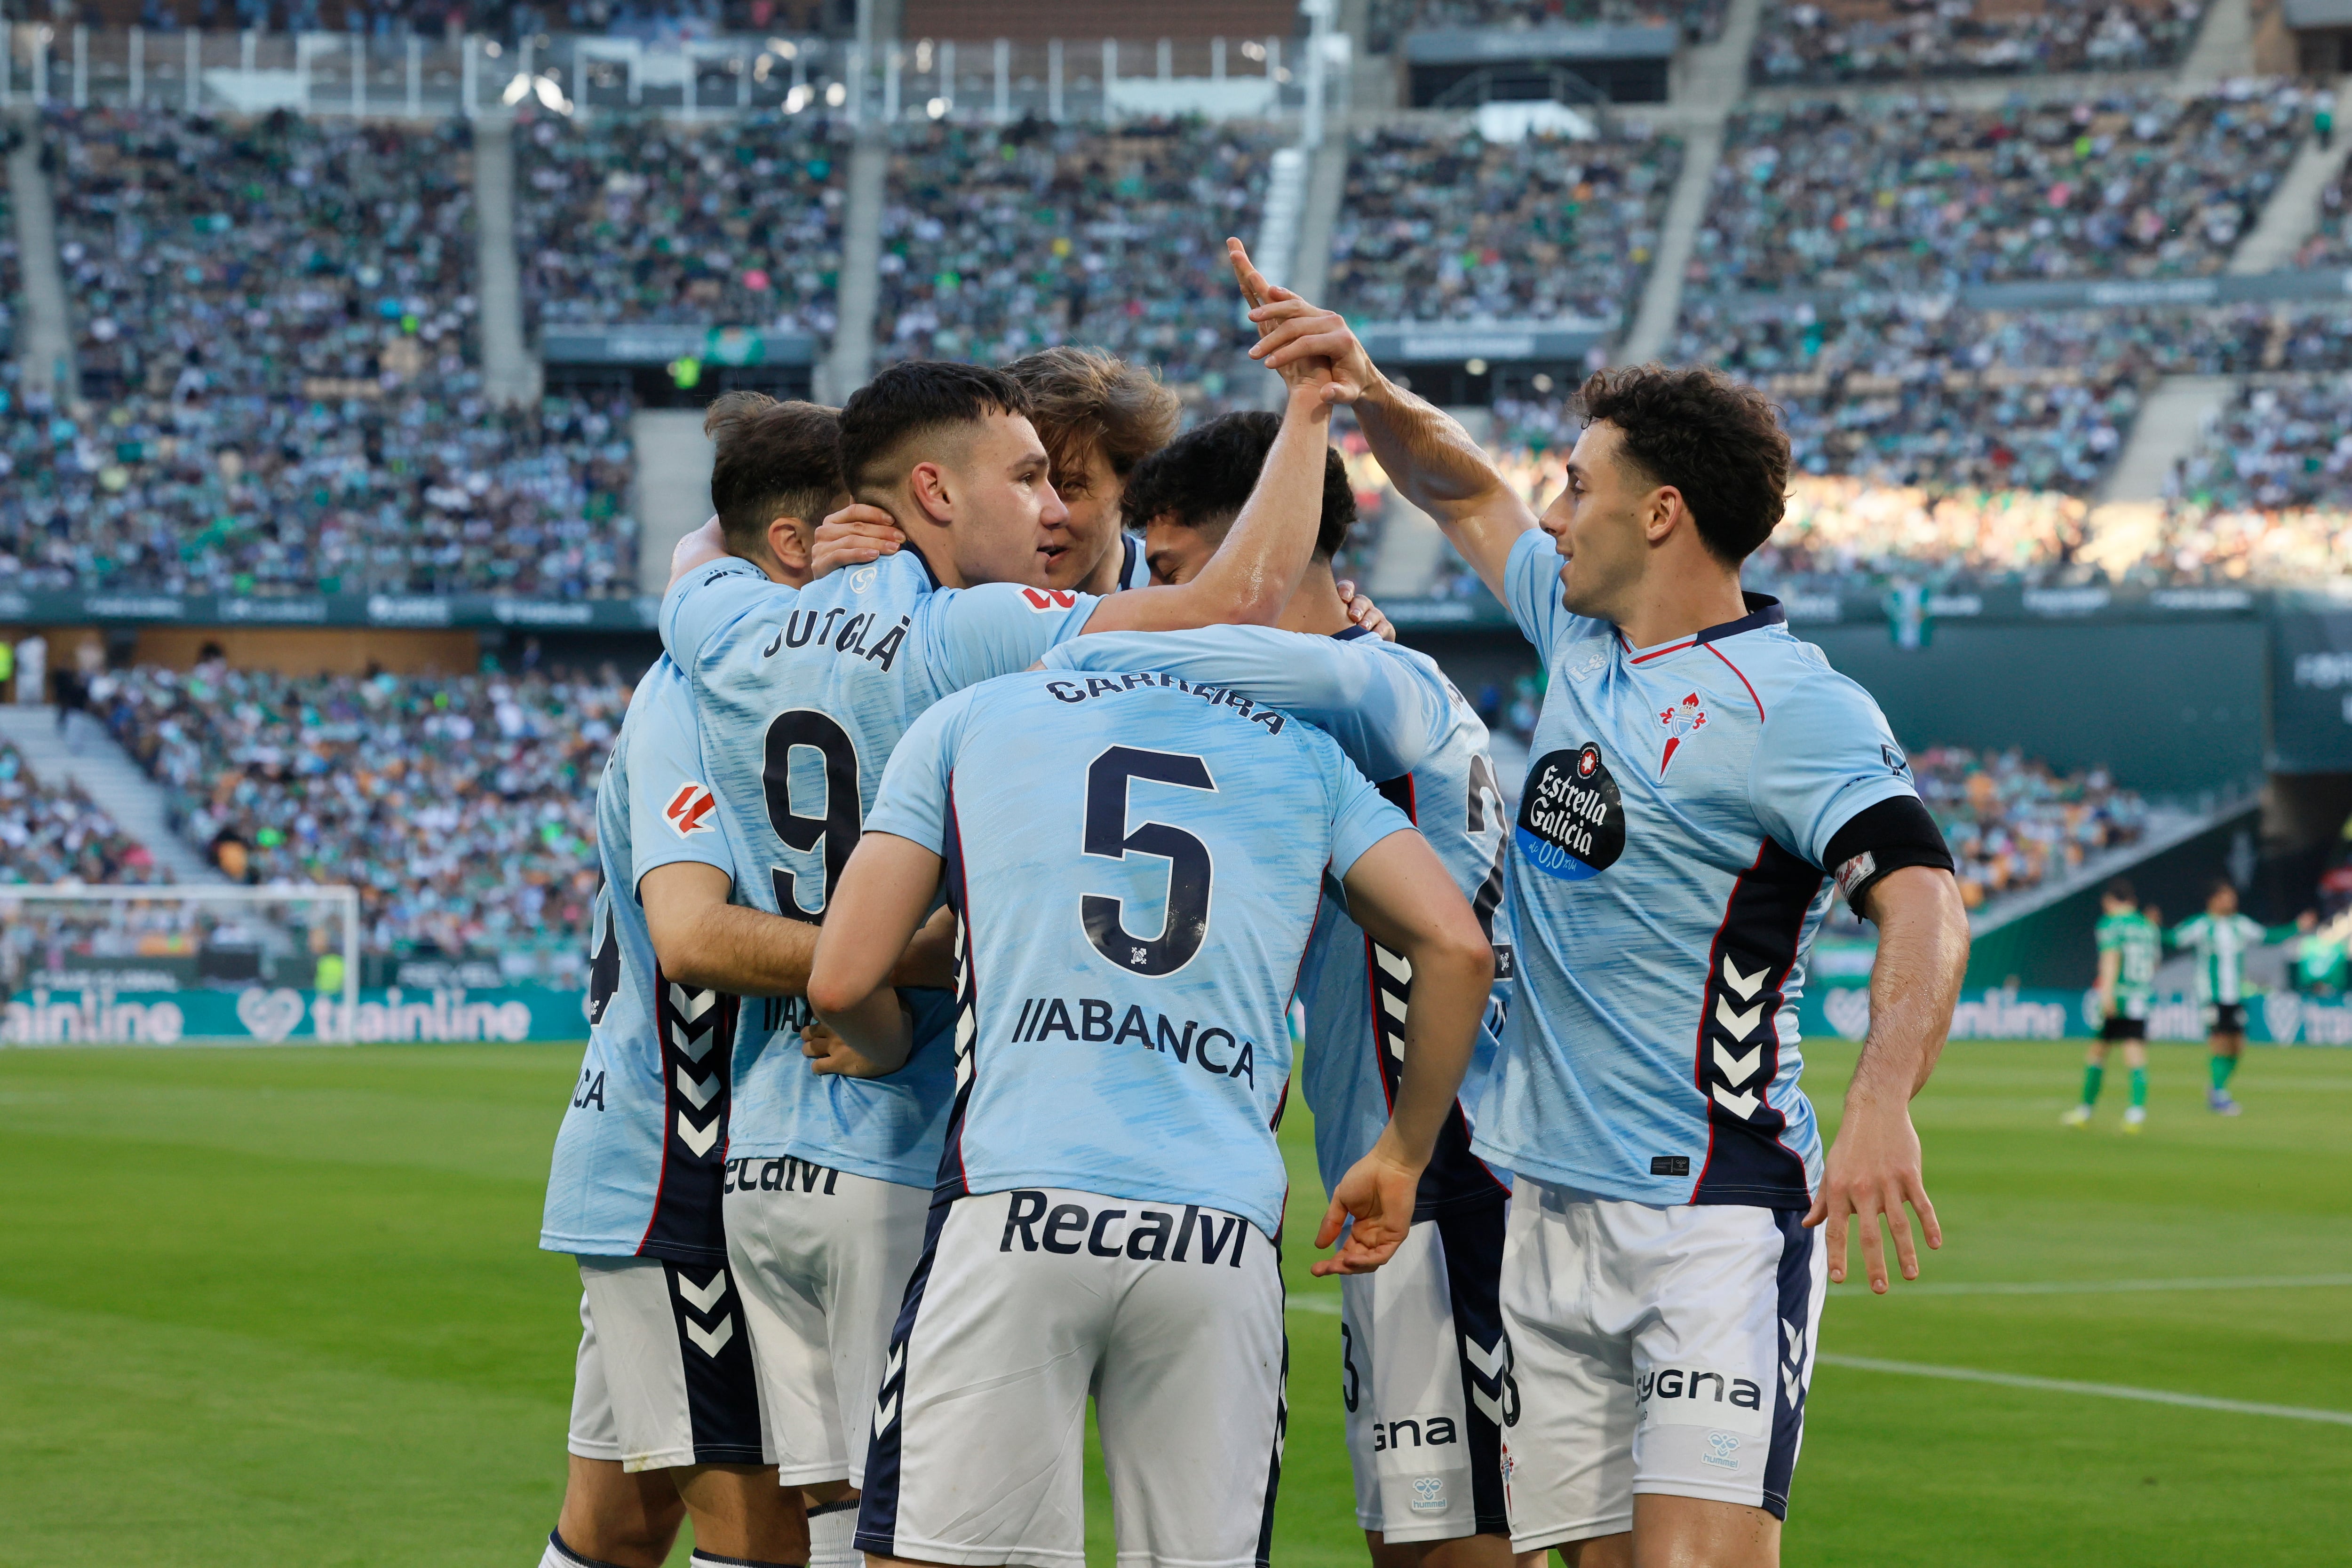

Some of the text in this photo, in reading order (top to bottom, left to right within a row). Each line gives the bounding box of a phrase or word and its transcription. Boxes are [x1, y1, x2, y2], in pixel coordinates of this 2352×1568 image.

[761, 707, 863, 927] 9
[1536, 764, 1607, 826] Estrella
[1530, 796, 1592, 856] Galicia
[1539, 840, 1565, 869] 0,0
[1079, 743, 1220, 979] 5
[1000, 1190, 1248, 1268] Recalvi
[1702, 1452, 1739, 1469] hummel
[1413, 1498, 1446, 1509] hummel
